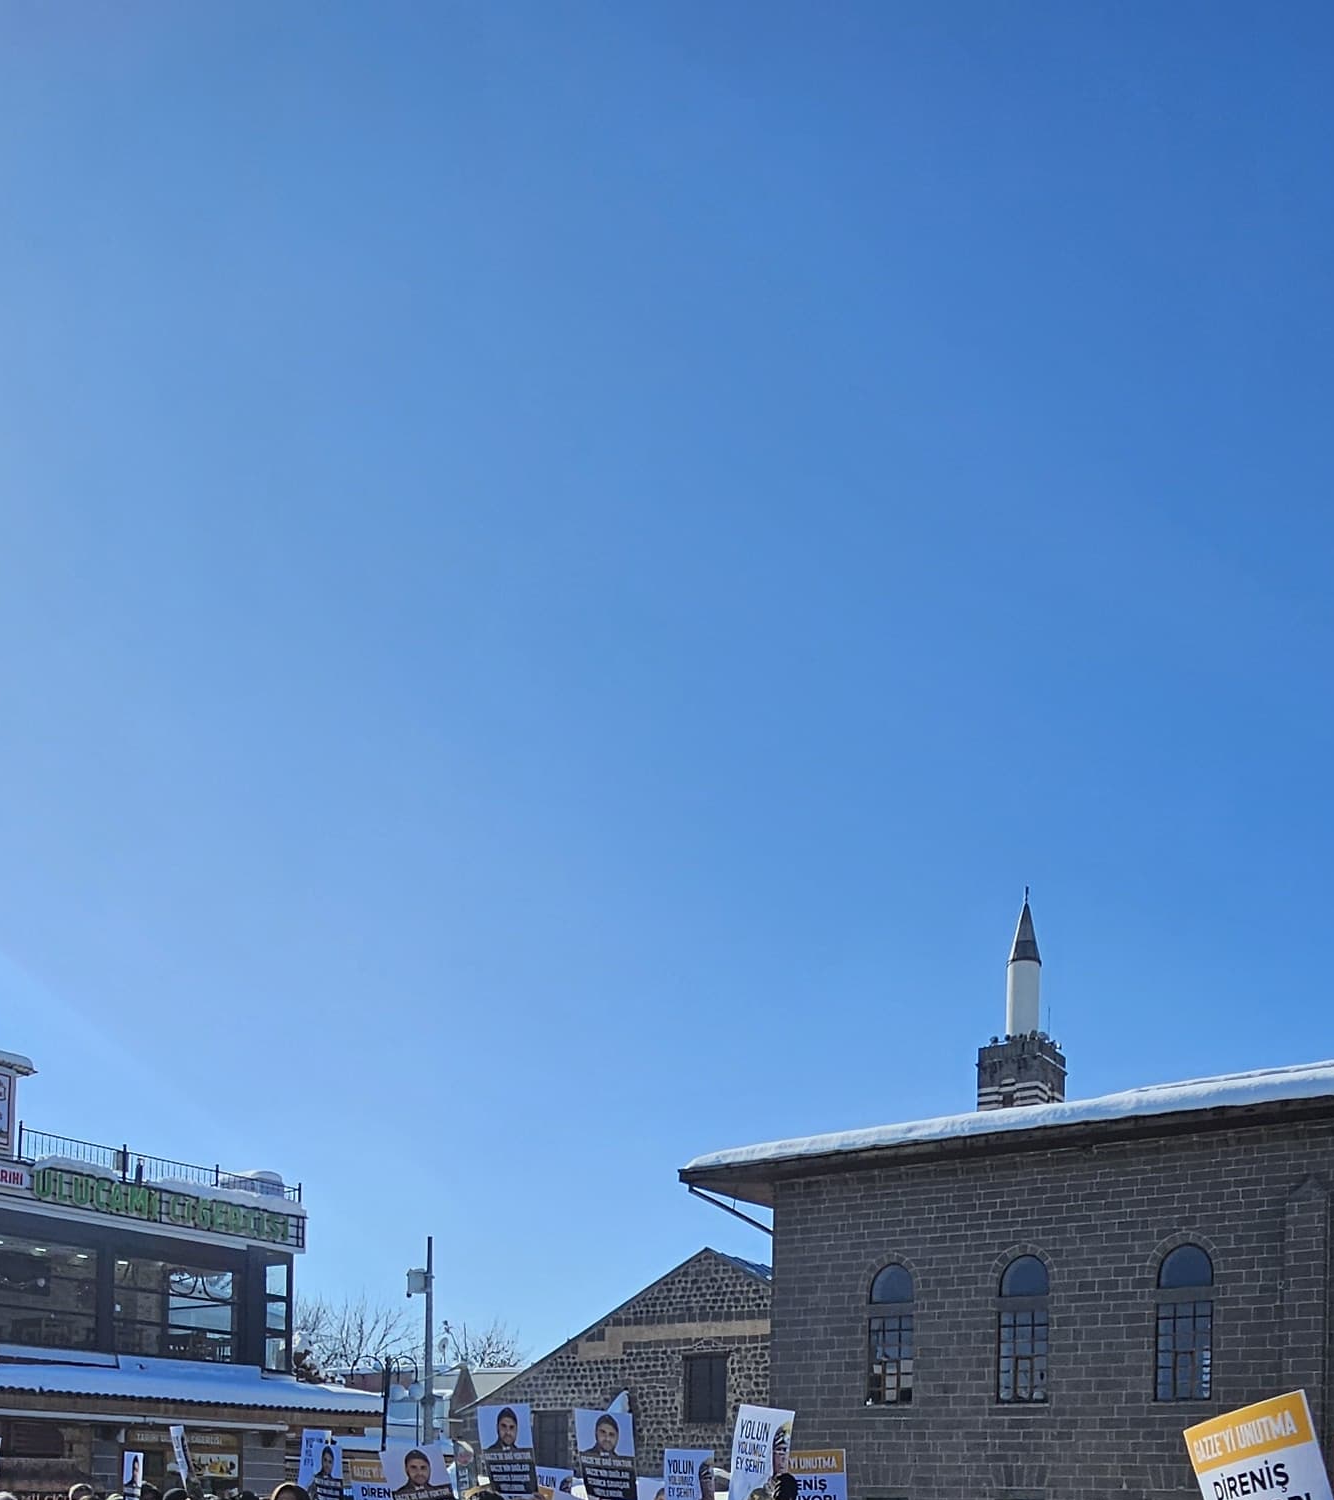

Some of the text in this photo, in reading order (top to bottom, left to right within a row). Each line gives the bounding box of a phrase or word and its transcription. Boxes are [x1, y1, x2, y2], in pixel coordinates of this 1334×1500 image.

[739, 1418, 771, 1440] YOLUN
[1237, 1409, 1298, 1449] UNUTMA
[668, 1459, 694, 1475] YOLUN
[735, 1456, 744, 1470] EY
[361, 1484, 391, 1499] DİREN
[795, 1475, 828, 1493] ENİŞ
